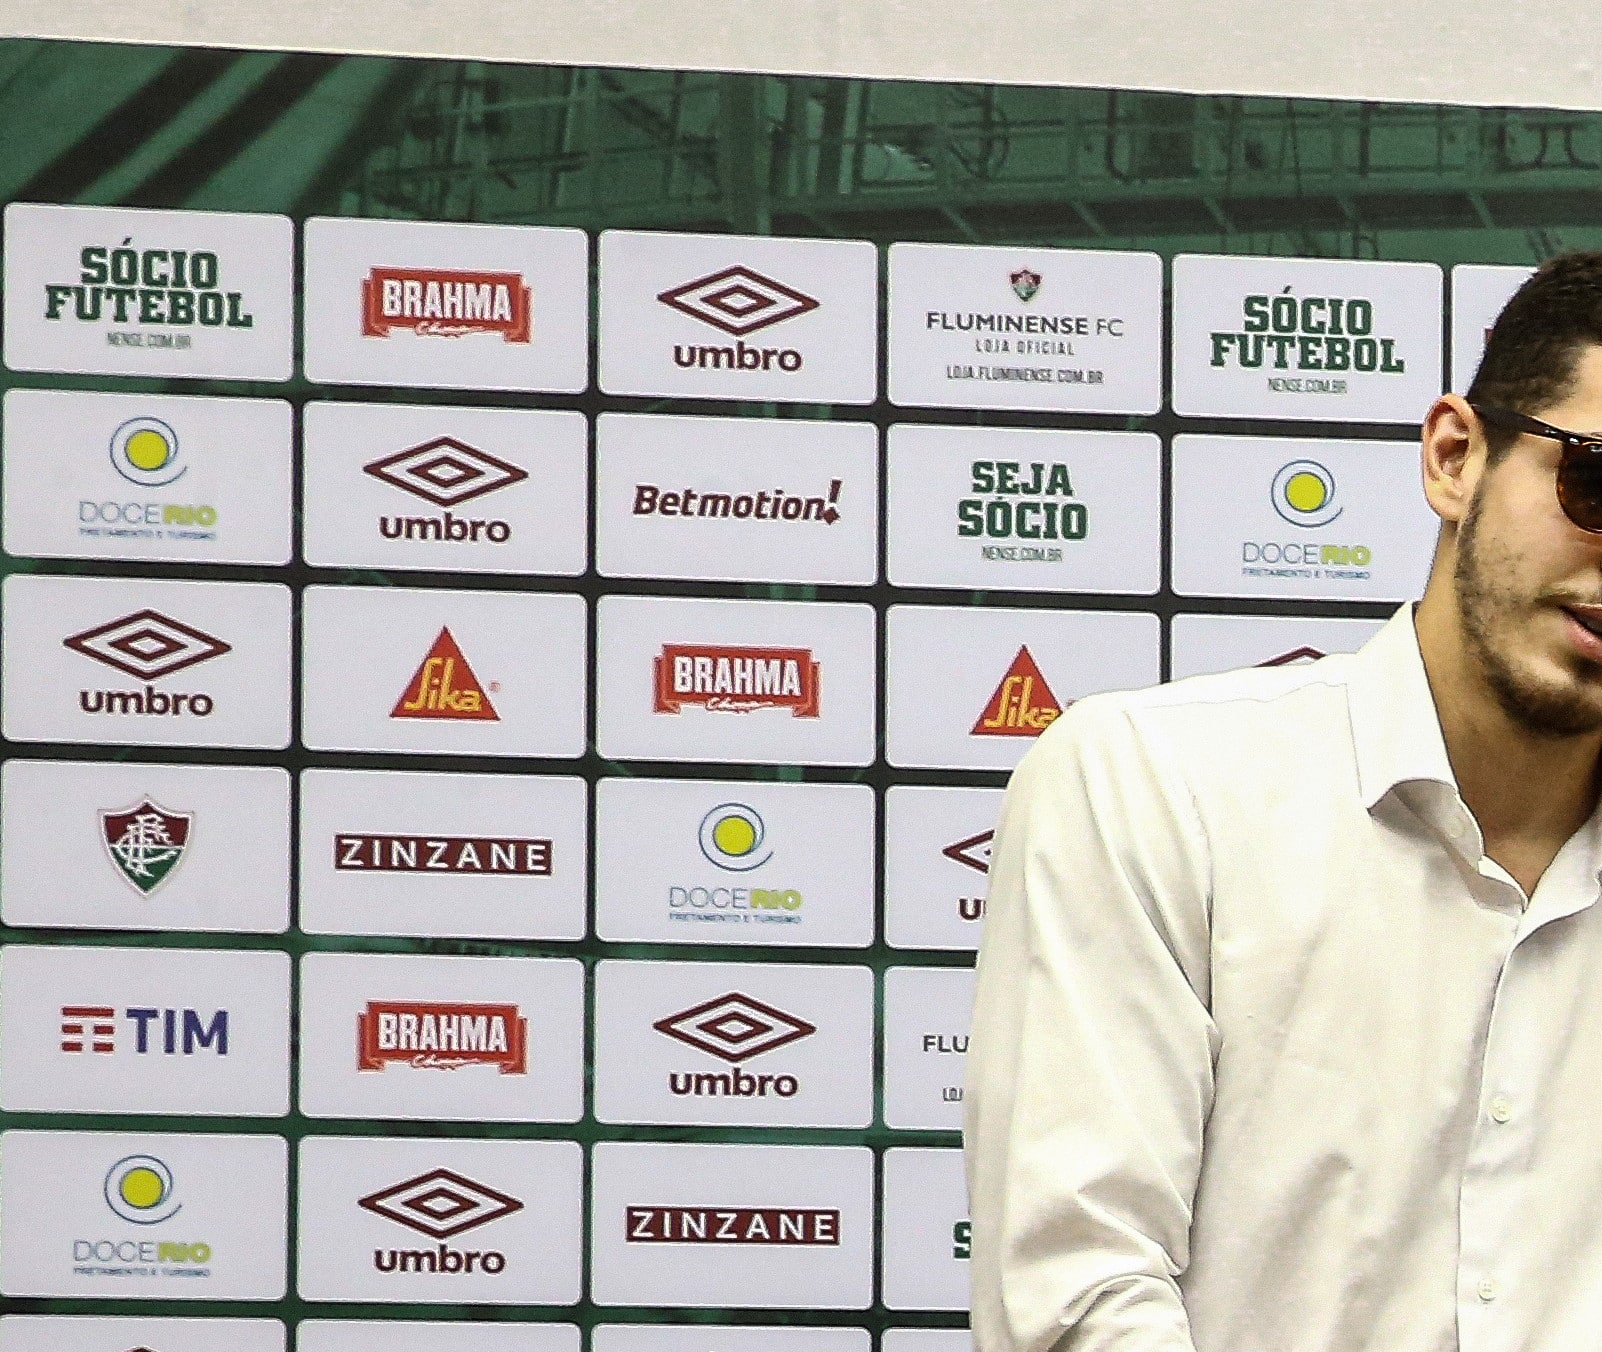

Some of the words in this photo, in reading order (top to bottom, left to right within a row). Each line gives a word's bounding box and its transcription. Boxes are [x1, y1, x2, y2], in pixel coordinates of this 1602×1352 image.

[80, 237, 218, 290] SÓCIO
[44, 285, 253, 328] FUTEBOL
[382, 279, 511, 320] BRAHMA
[1243, 286, 1372, 336] SÓCIO
[926, 311, 1089, 337] FLUMINENSE
[1096, 318, 1124, 337] FC
[673, 340, 803, 372] umbro
[1210, 332, 1404, 373] FUTEBOL
[971, 461, 1074, 497] SEJA
[633, 479, 843, 525] Betmotion!
[957, 496, 1088, 541] SÓCIO
[379, 511, 512, 542] umbro
[673, 656, 799, 695] BRAHMA
[79, 685, 214, 717] umbro
[342, 839, 546, 870] ZINZANE
[127, 1009, 228, 1054] TIM
[377, 1013, 507, 1052] BRAHMA
[633, 1212, 833, 1240] ZINZANE
